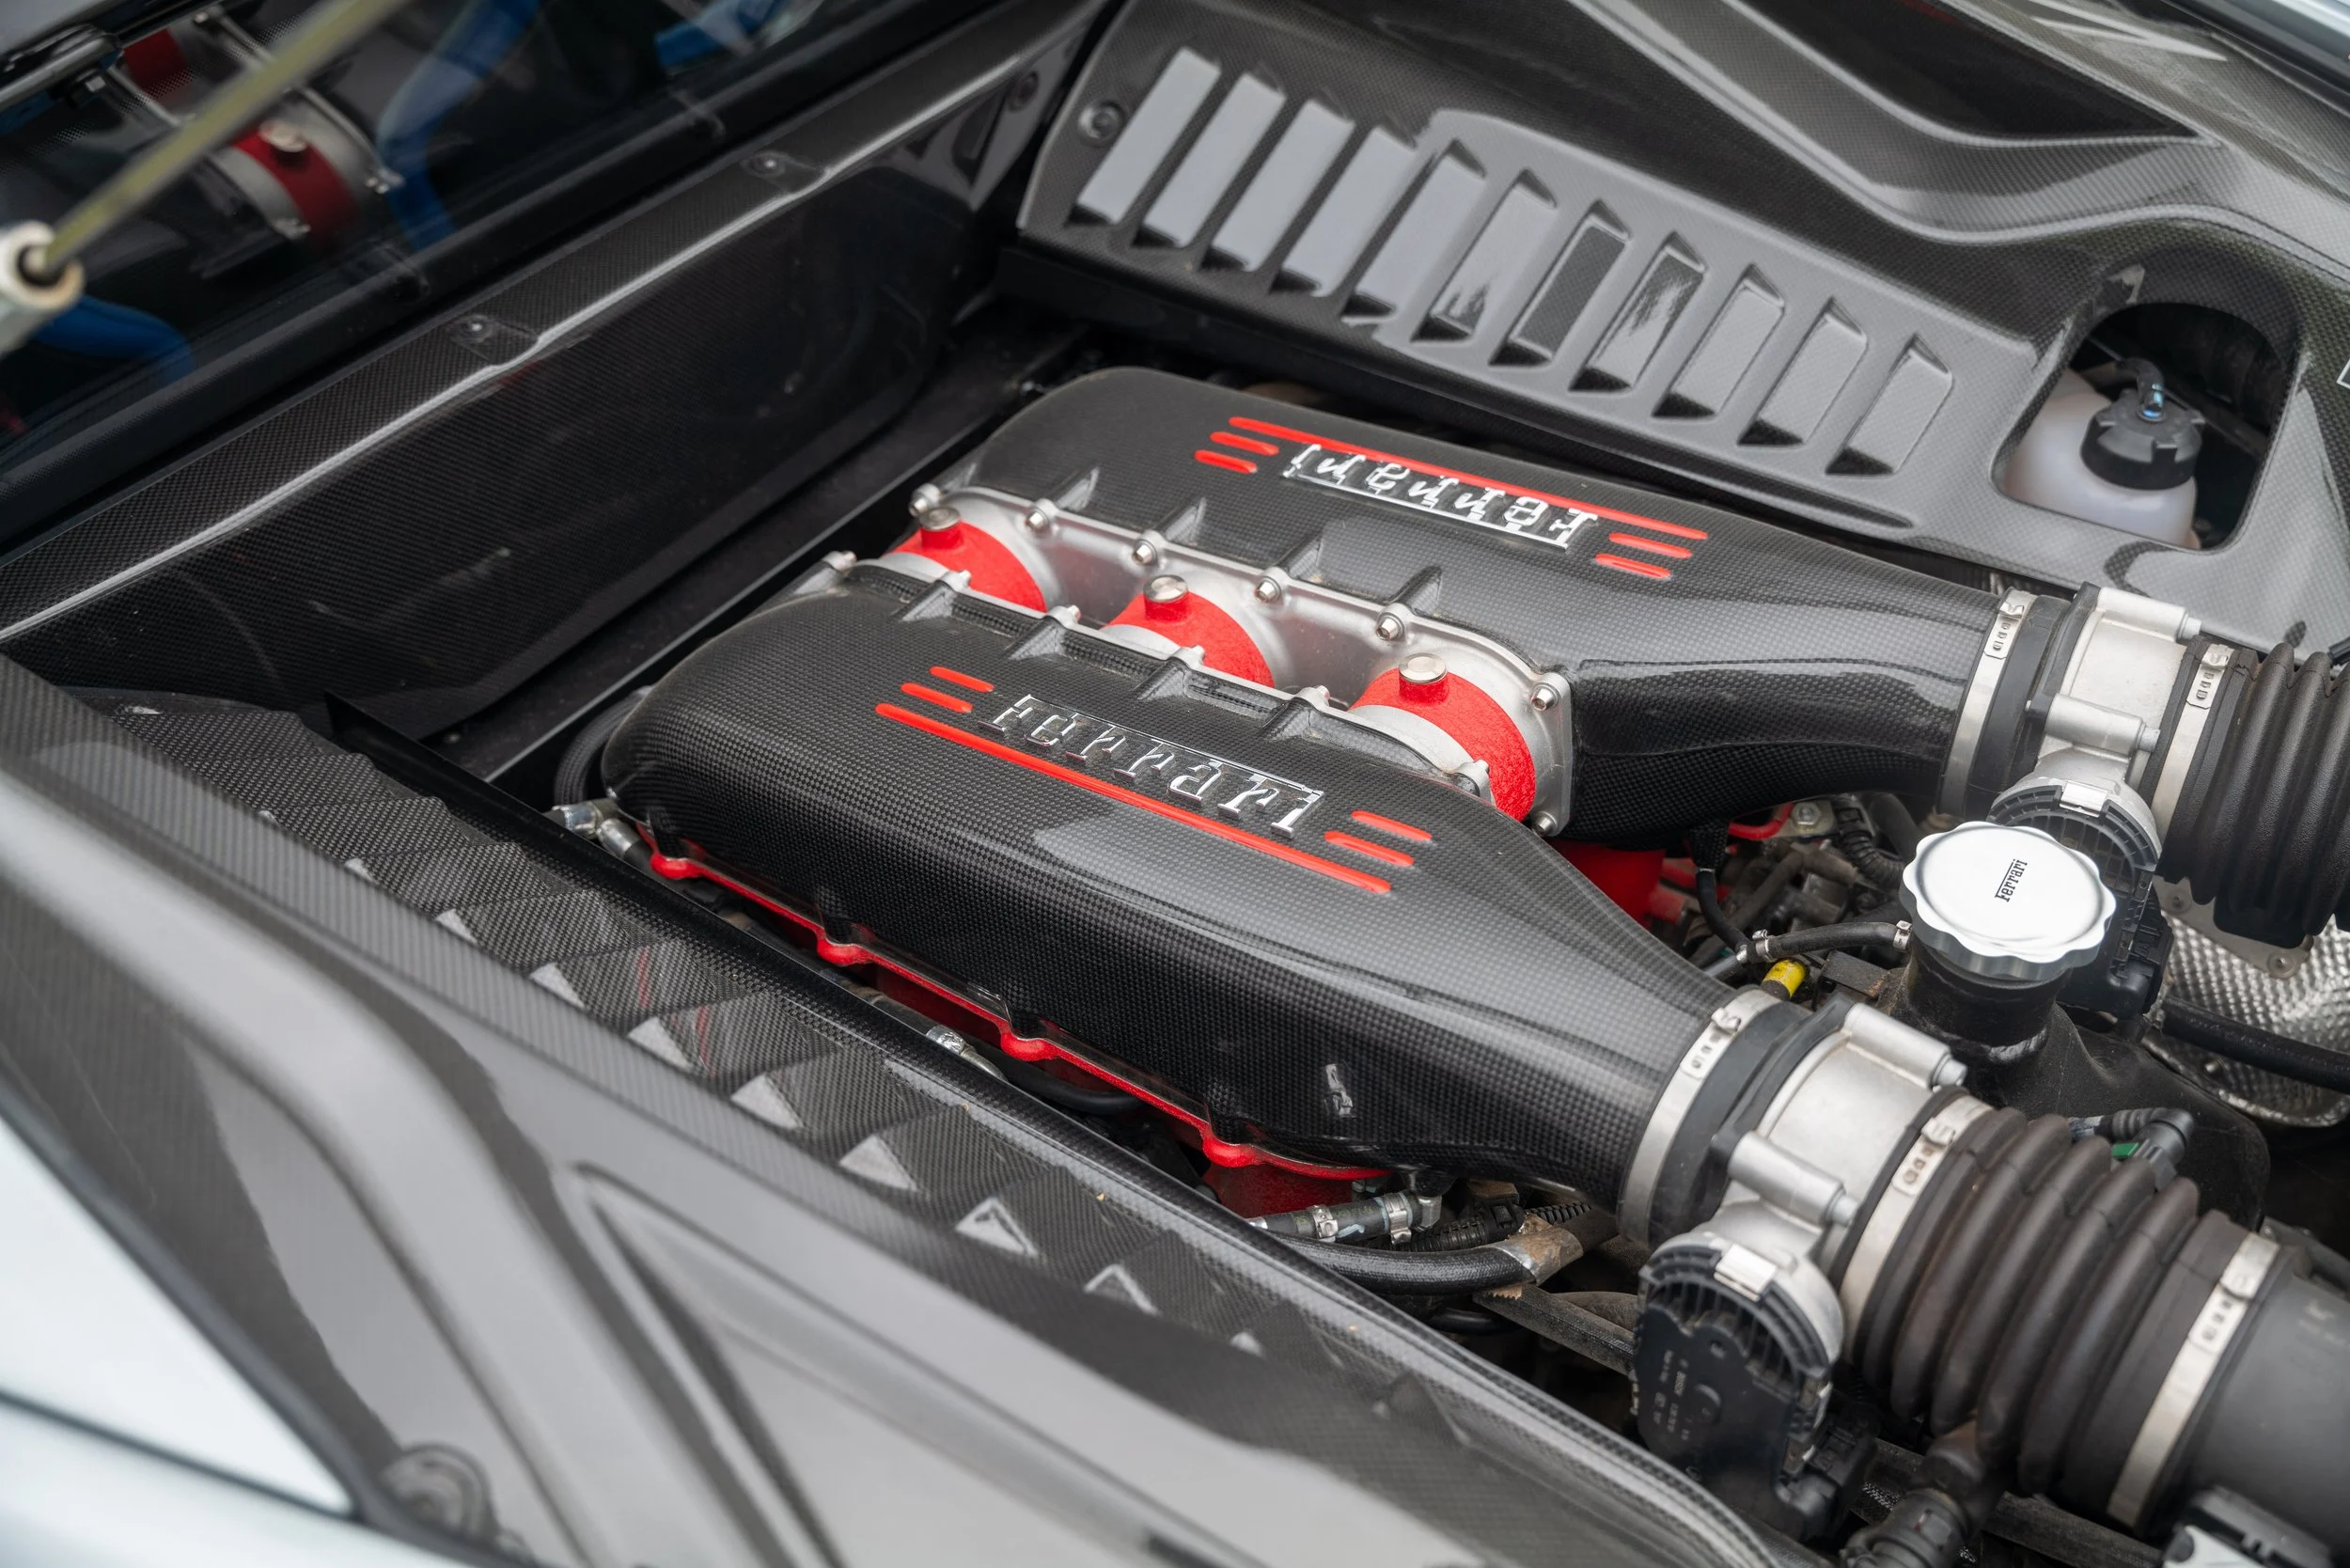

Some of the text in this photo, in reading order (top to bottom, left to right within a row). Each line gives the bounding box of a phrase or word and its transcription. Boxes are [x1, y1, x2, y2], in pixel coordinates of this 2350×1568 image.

[1283, 444, 1598, 549] Ferrari
[977, 694, 1324, 838] Ferrari
[1995, 857, 2028, 902] Ferrari
